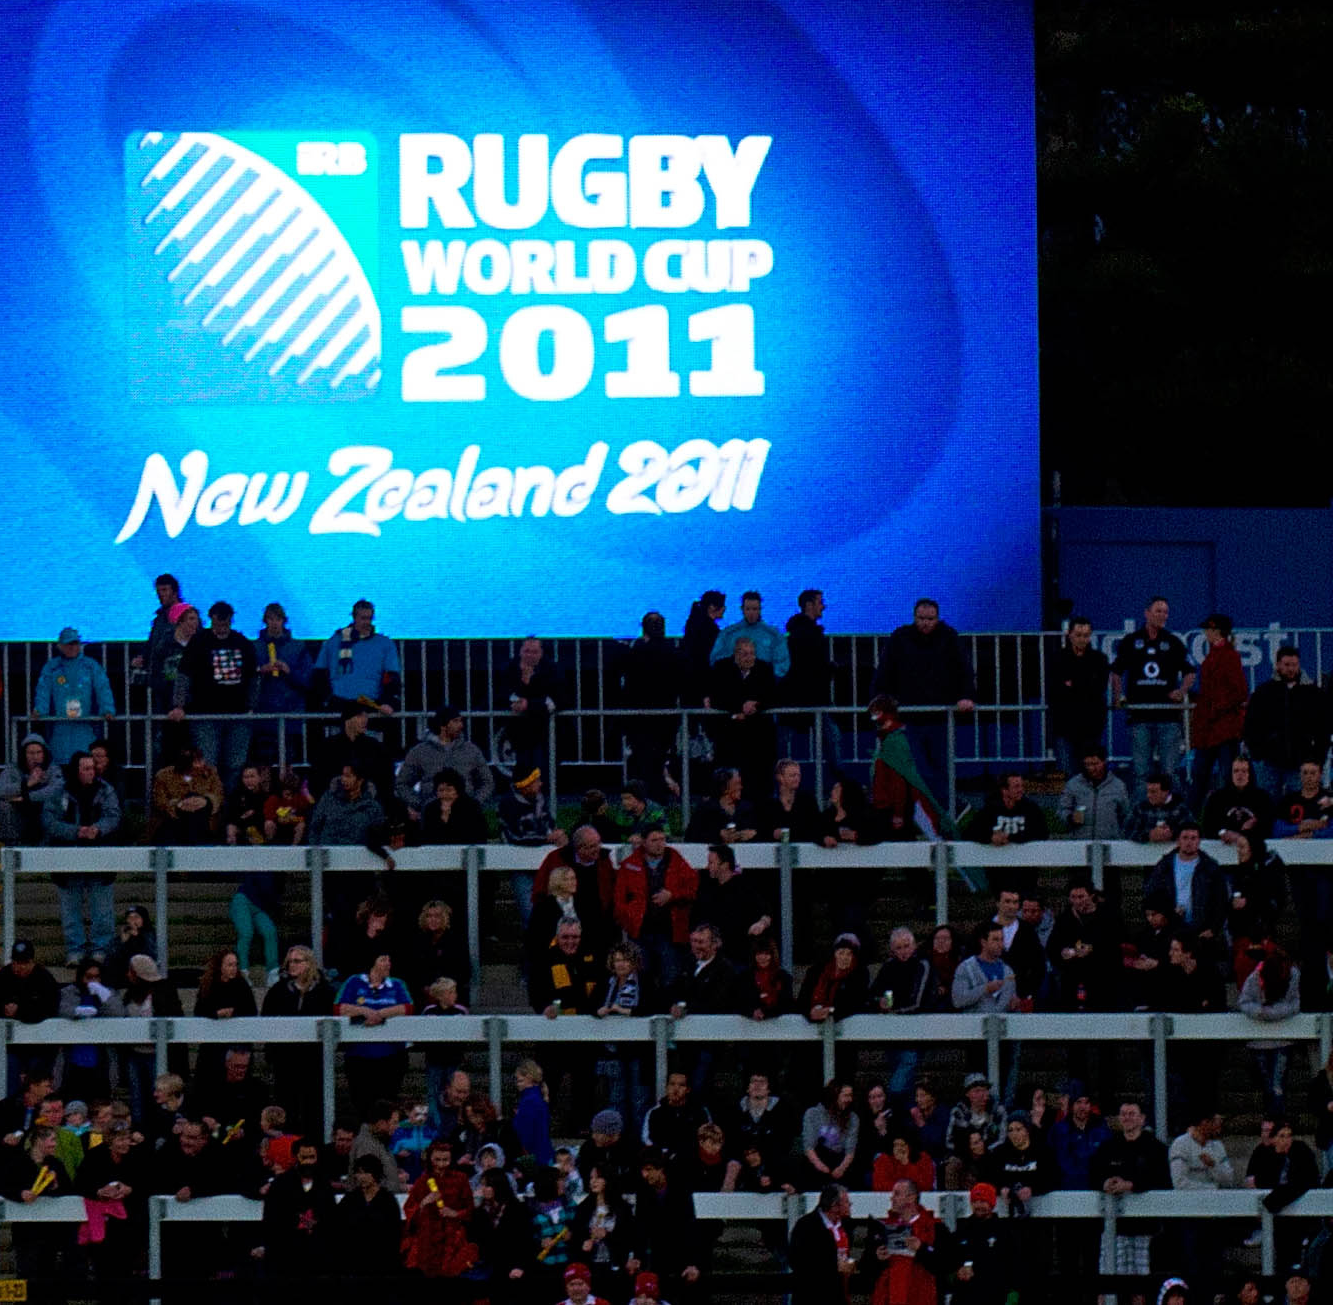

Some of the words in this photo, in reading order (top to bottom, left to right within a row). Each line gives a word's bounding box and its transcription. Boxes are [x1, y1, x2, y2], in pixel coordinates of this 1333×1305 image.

[399, 132, 773, 230] RUGBY
[400, 239, 638, 295] WORLD
[643, 239, 775, 294] CUP
[400, 304, 766, 403] 2011
[114, 449, 310, 543] New
[308, 443, 610, 537] Zealand
[606, 437, 772, 515] 2011
